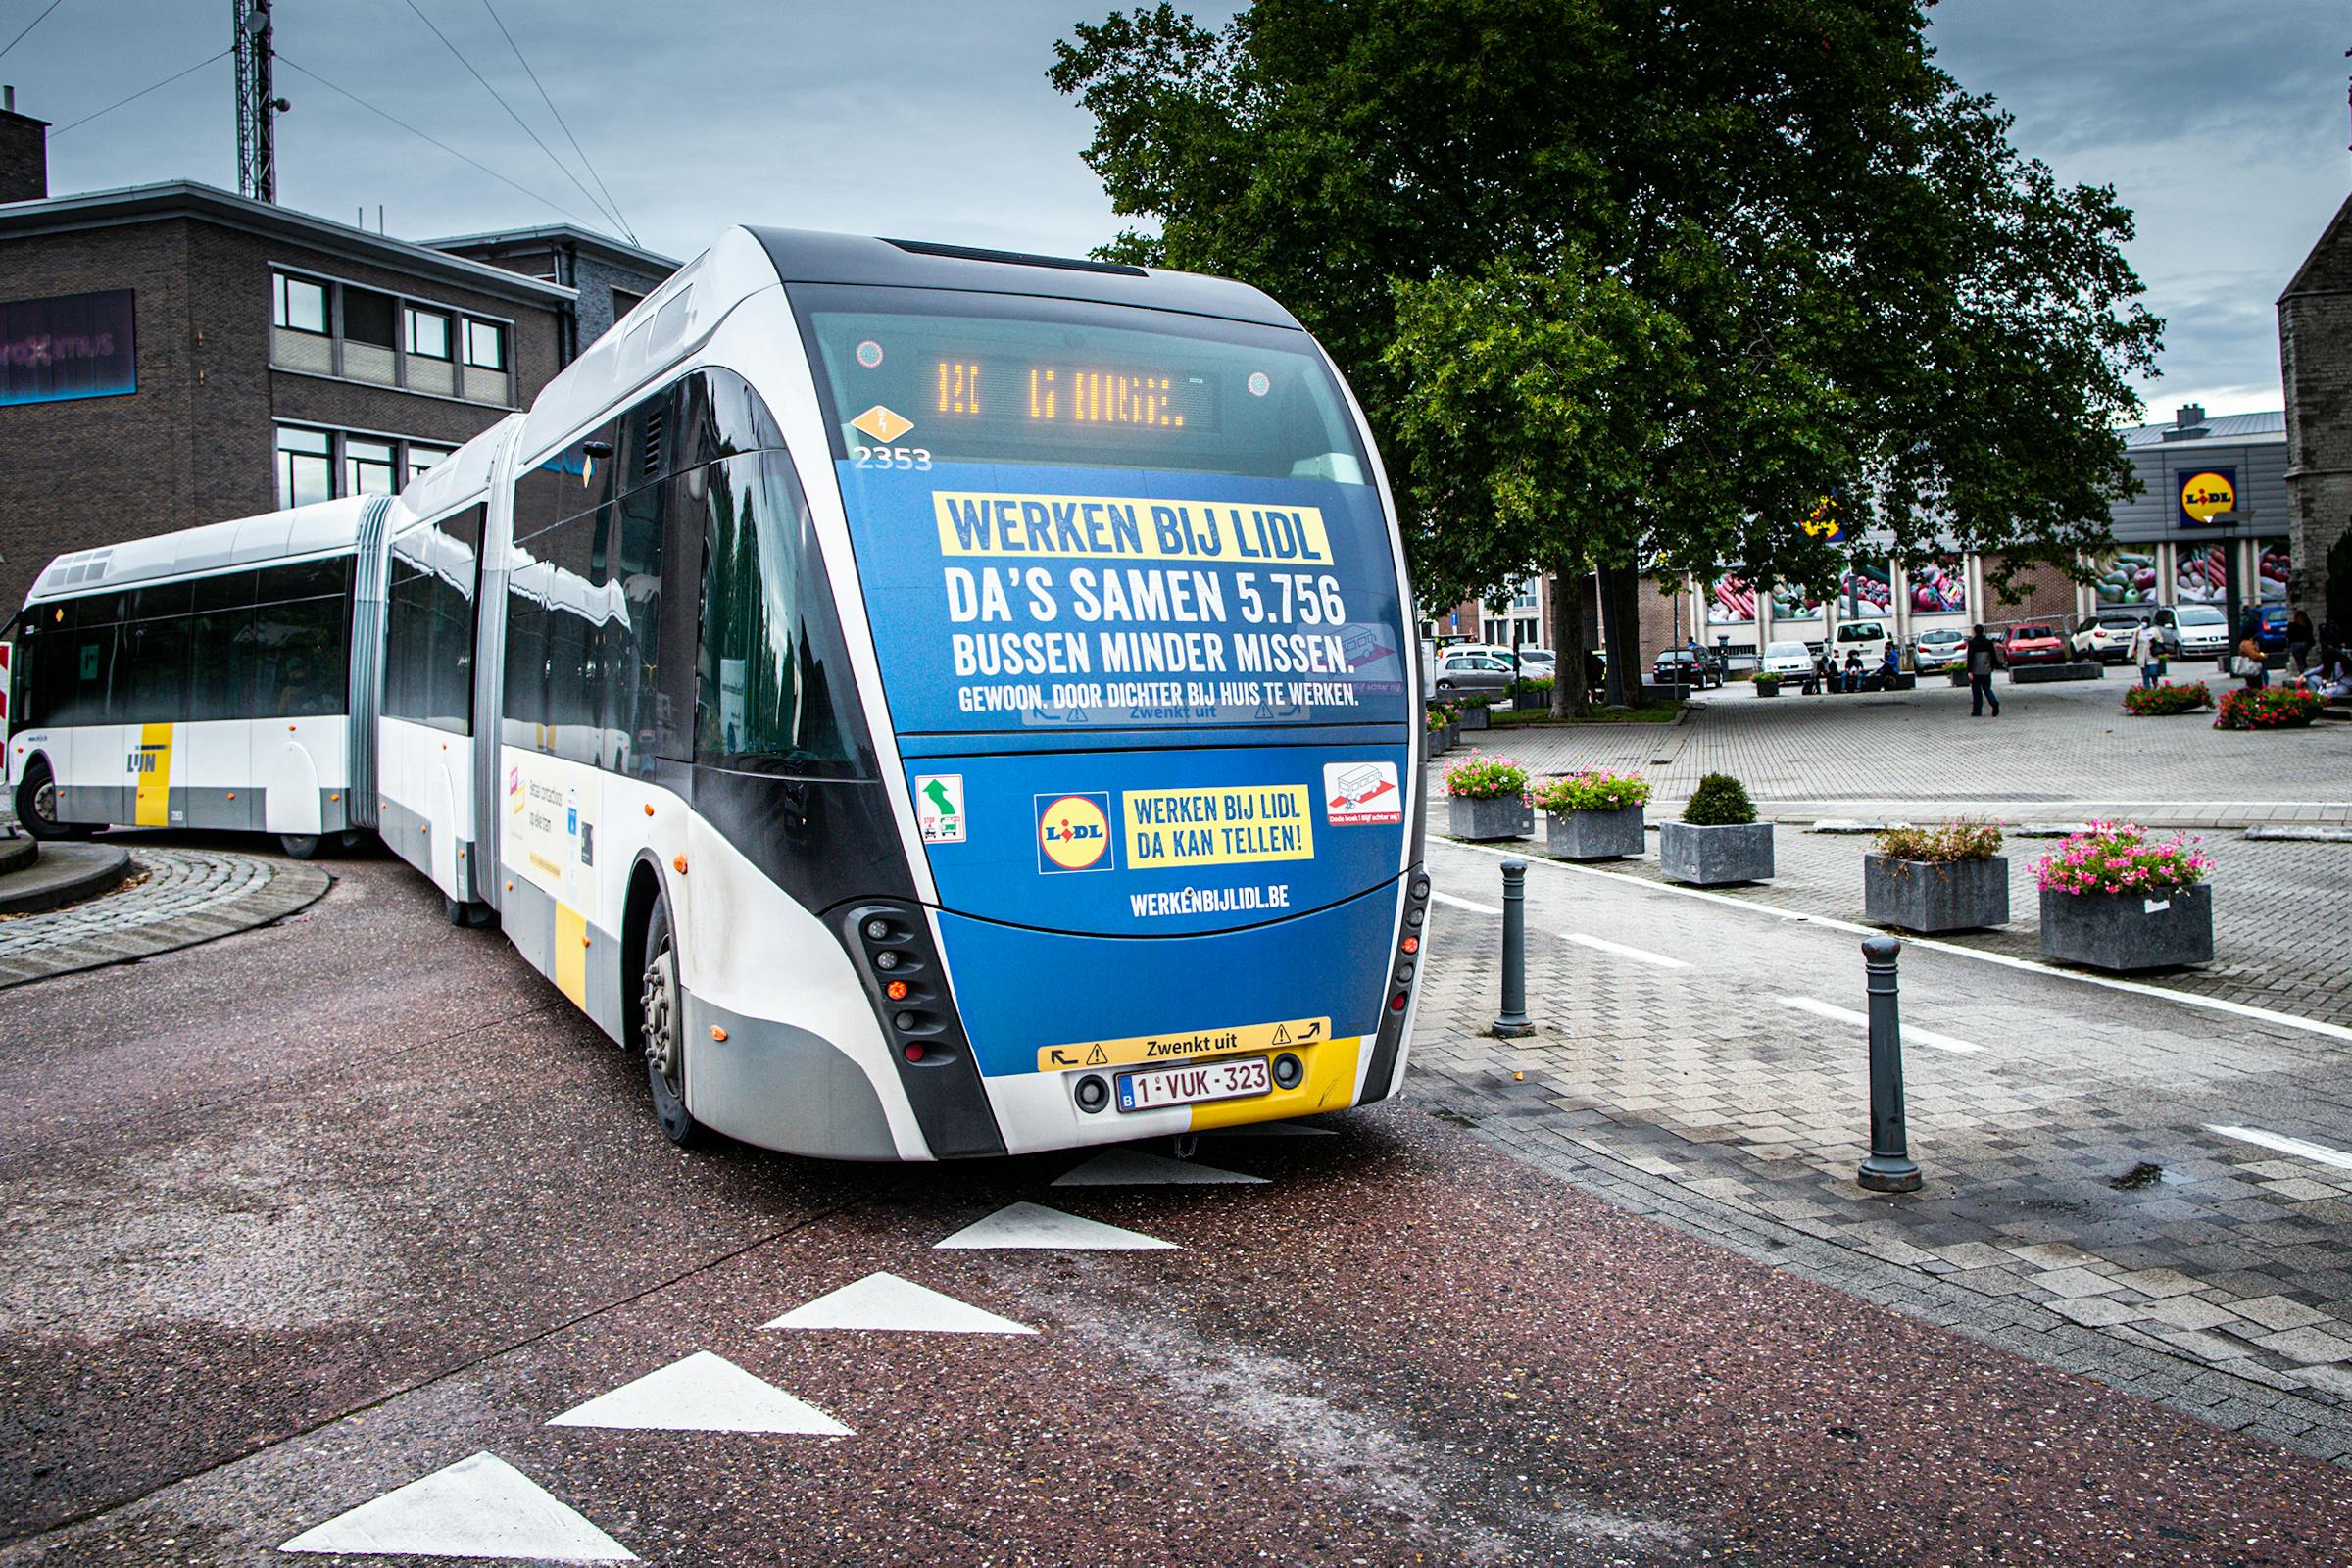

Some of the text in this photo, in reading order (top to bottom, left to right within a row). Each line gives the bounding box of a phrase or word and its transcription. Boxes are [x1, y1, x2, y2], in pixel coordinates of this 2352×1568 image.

[853, 446, 933, 471] 2353
[946, 499, 1322, 561] WERKEN BIJ LIDL
[944, 566, 1347, 625] DA'S SAMEN 5.756
[953, 632, 1356, 677] BUSSEN MINDER MISSEN.
[958, 682, 1359, 712] GEWOON. DOOR DICHTER BIJ HUIS TE WERKEN.
[1130, 704, 1217, 719] Zwenkt uit
[1134, 792, 1300, 824] WERKEN BIJ LIDL
[1137, 824, 1302, 858] DA KAN TELLEN!
[1130, 884, 1290, 917] WERKENBIJLIDL.BE
[1147, 1033, 1237, 1057] Zwenkt uit
[1123, 1095, 1133, 1107] B
